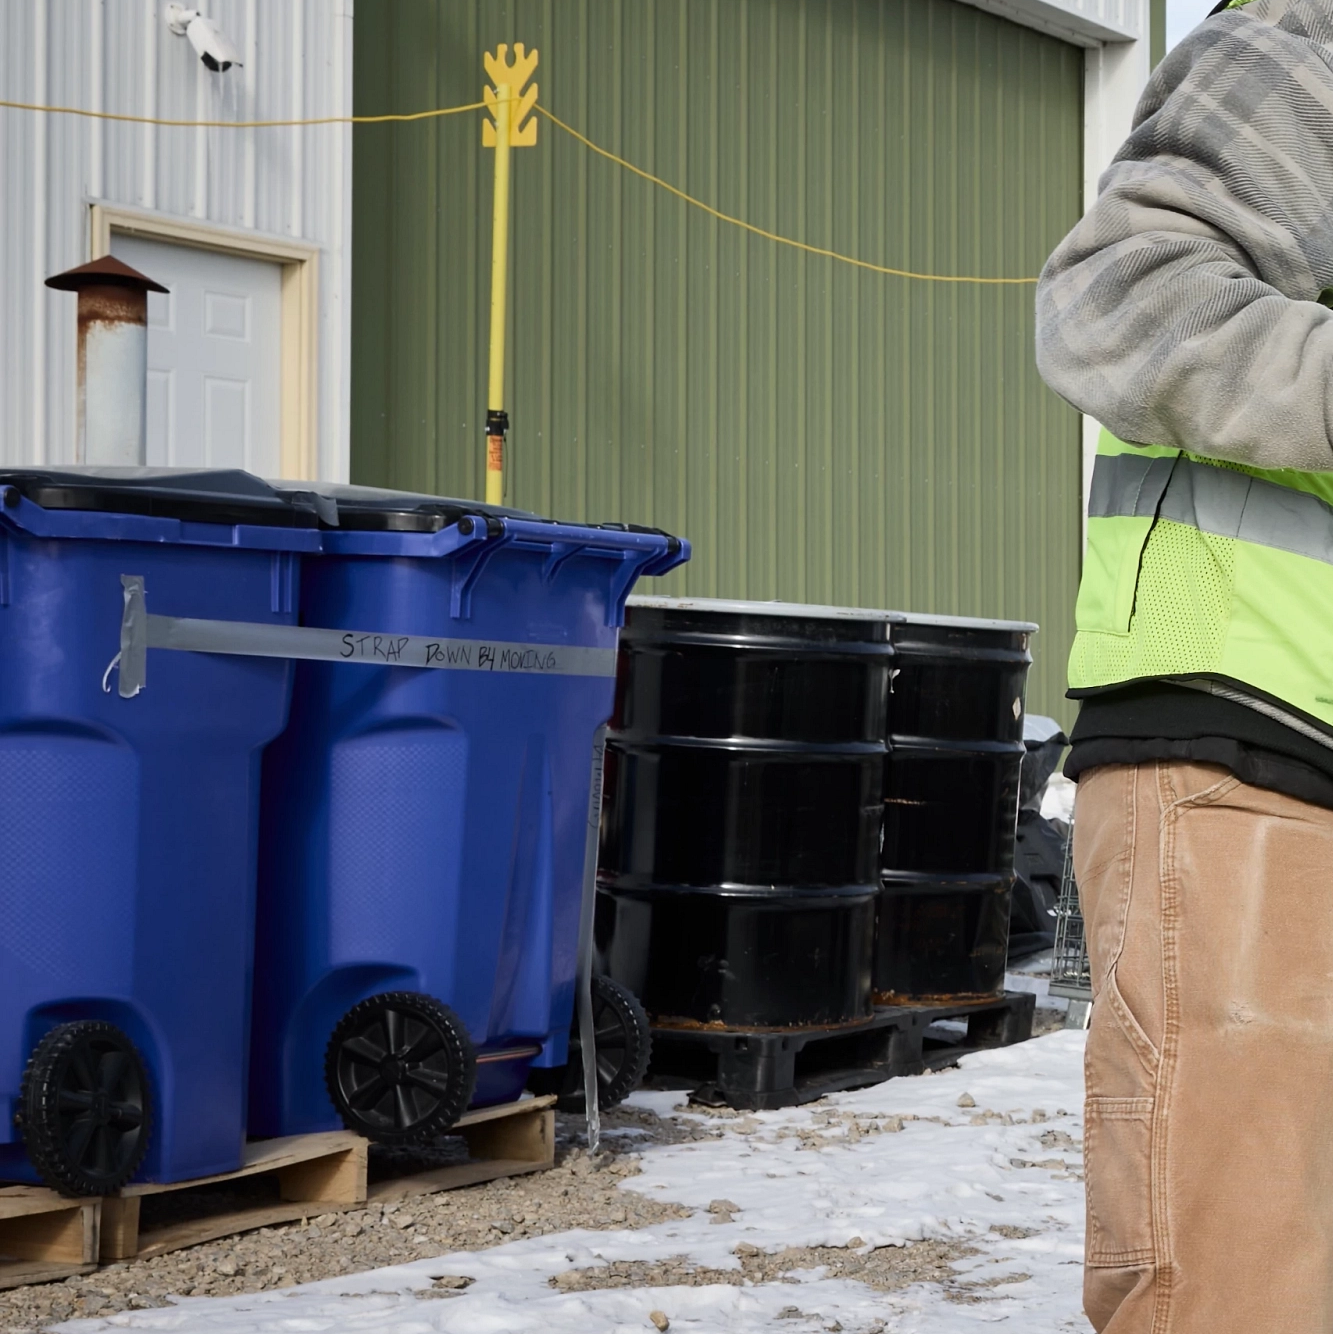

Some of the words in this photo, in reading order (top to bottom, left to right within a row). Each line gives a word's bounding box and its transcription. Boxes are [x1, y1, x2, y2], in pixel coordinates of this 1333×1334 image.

[339, 633, 409, 662] STRAP
[425, 643, 472, 665] DOWN
[500, 648, 556, 670] MOVING
